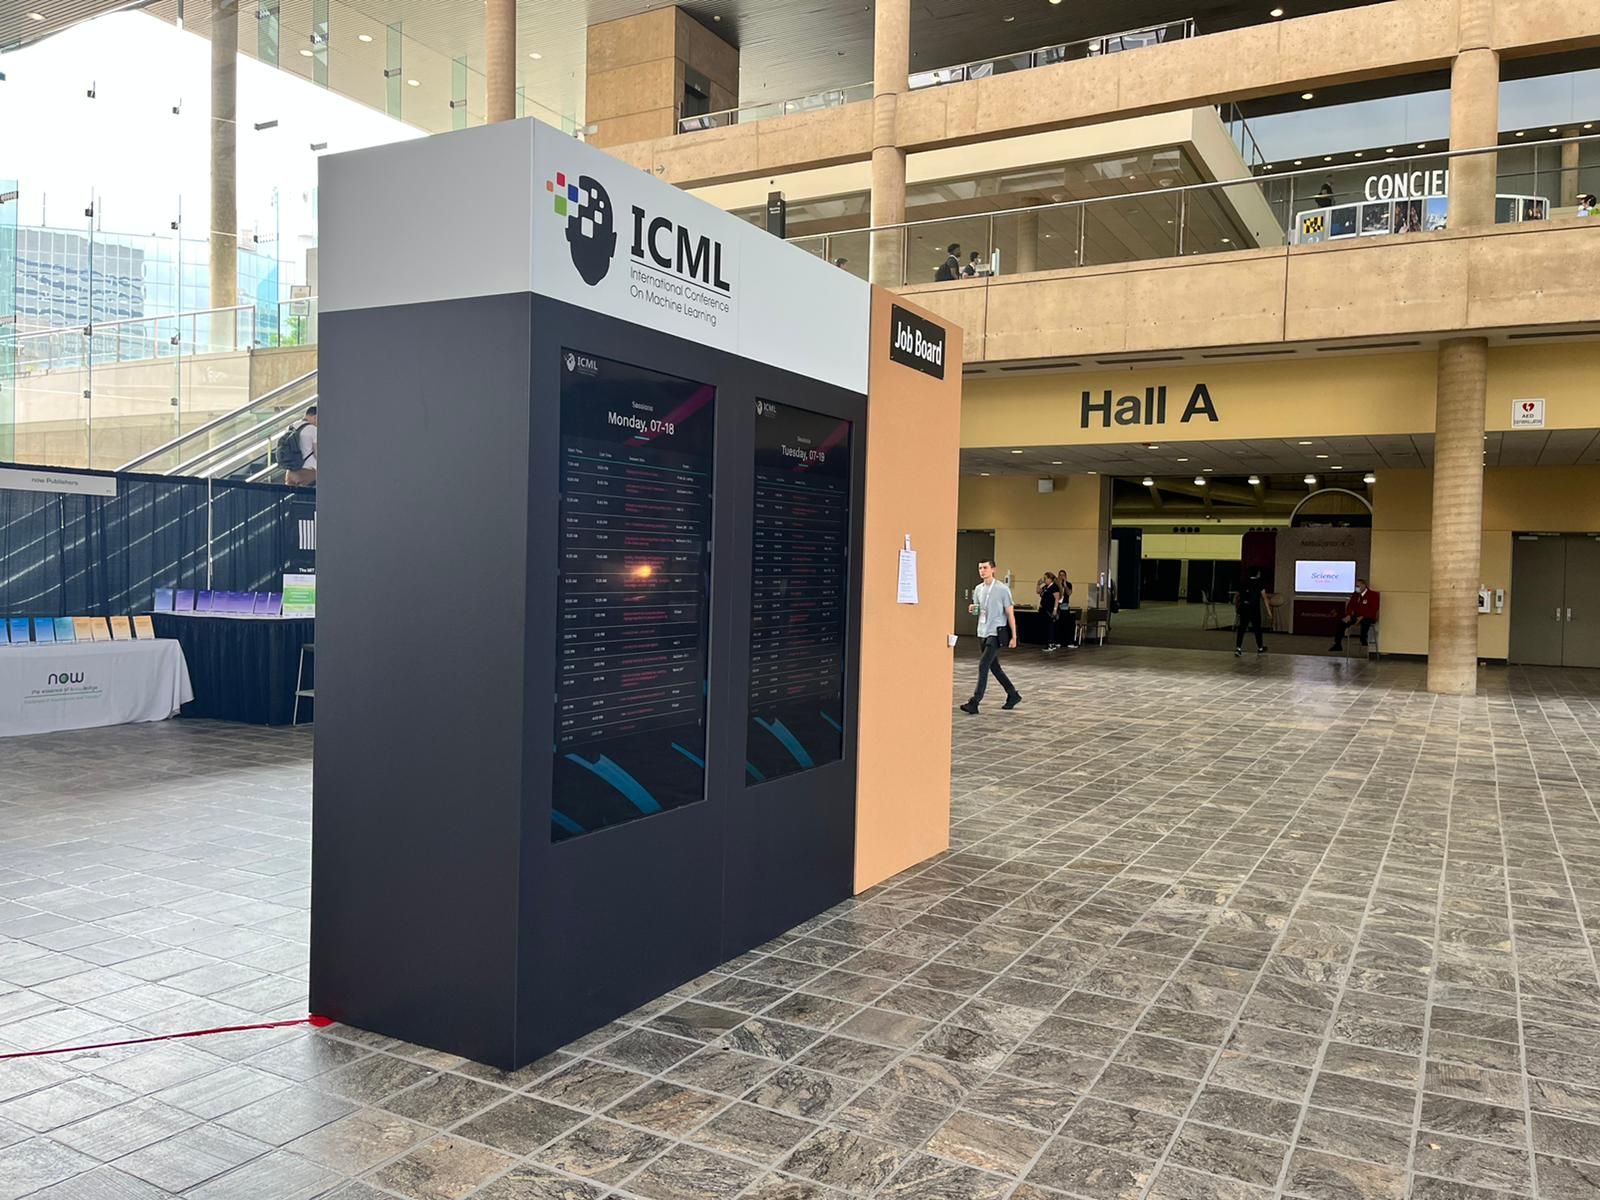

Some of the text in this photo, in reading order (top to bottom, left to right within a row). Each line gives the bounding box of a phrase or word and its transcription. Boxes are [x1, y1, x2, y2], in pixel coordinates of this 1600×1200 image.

[631, 204, 730, 292] ICML
[630, 266, 729, 312] International Conference
[630, 284, 717, 327] On Machine Learning
[895, 321, 942, 366] Job Board
[577, 356, 598, 370] ICML
[1080, 383, 1219, 428] Hall A
[608, 411, 675, 435] Monday, 07-18
[781, 444, 808, 461] Tuesday,
[46, 478, 79, 486] Publishers
[47, 672, 84, 685] now
